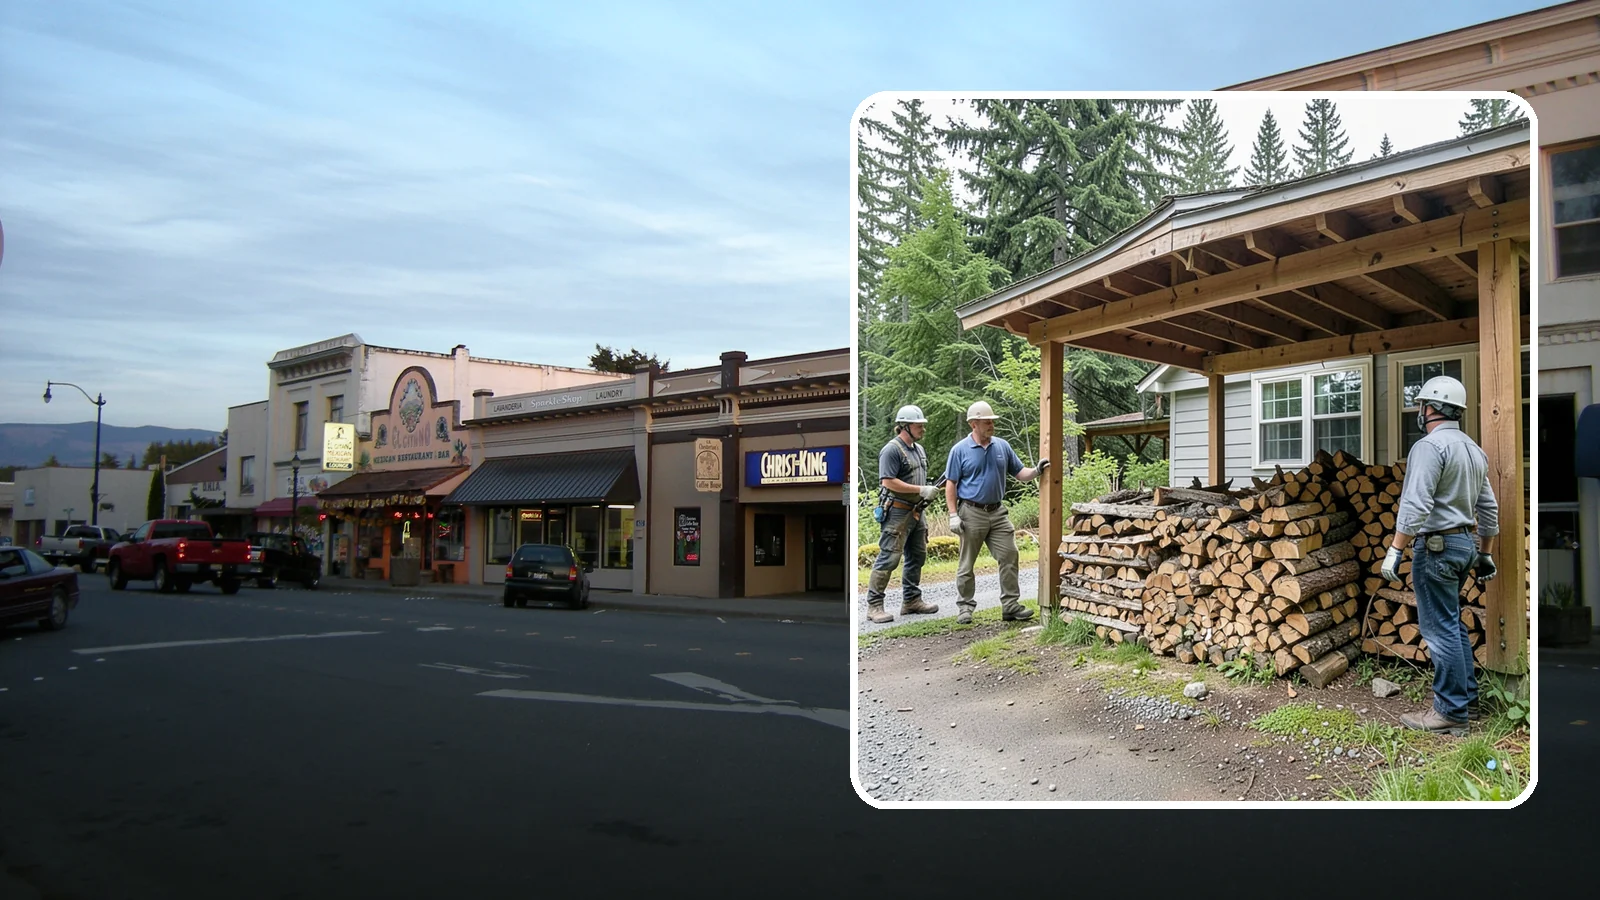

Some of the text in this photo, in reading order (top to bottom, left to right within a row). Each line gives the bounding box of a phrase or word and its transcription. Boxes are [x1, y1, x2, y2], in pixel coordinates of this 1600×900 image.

[493, 389, 623, 412] LAVANDERIA Sparkle Shop LAUNDRY
[373, 455, 396, 464] MEXICAN
[397, 452, 433, 461] RESTAURANT
[438, 450, 450, 459] BAR
[799, 450, 827, 476] KING
[697, 480, 721, 488] Coffee House
